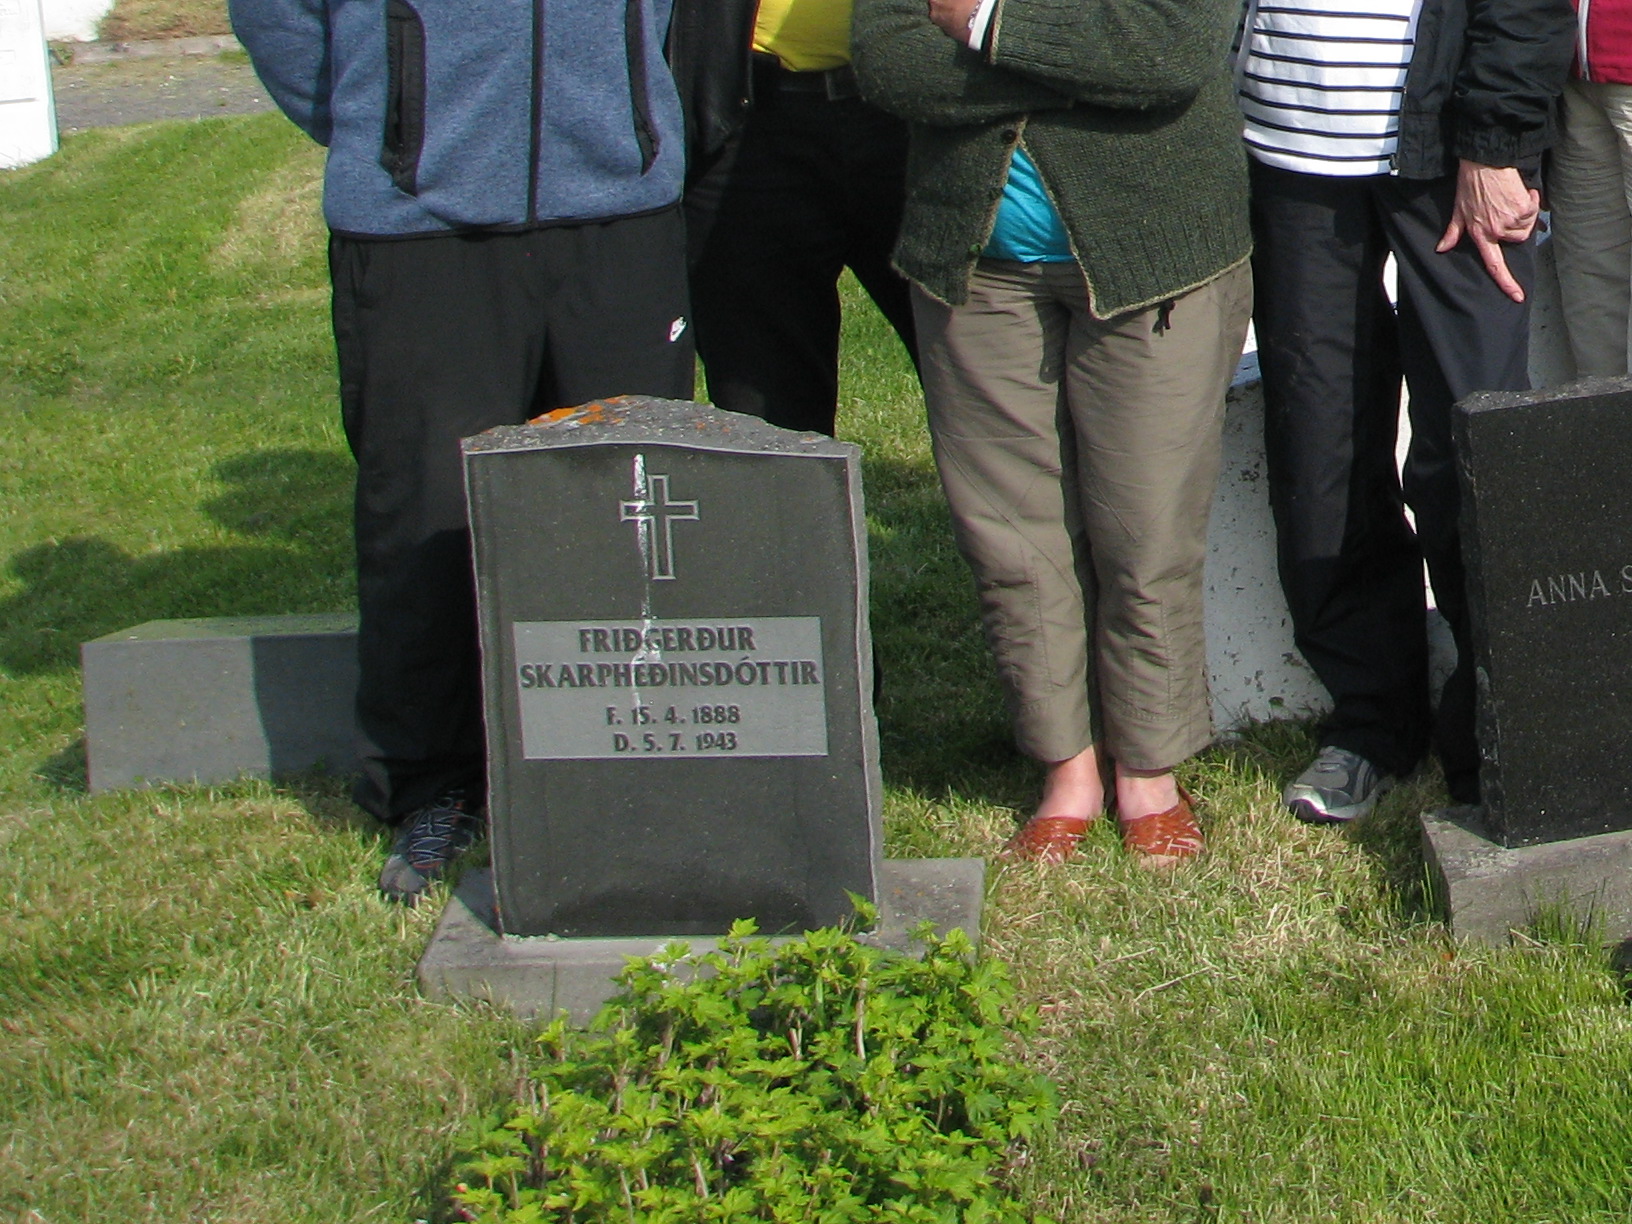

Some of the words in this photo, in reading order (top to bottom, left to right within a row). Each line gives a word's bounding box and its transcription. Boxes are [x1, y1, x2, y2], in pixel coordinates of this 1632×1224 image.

[1526, 569, 1611, 608] ANNA
[578, 626, 757, 653] FRIÐGERÐUR
[692, 704, 740, 724] 1888
[695, 731, 738, 751] 1943
